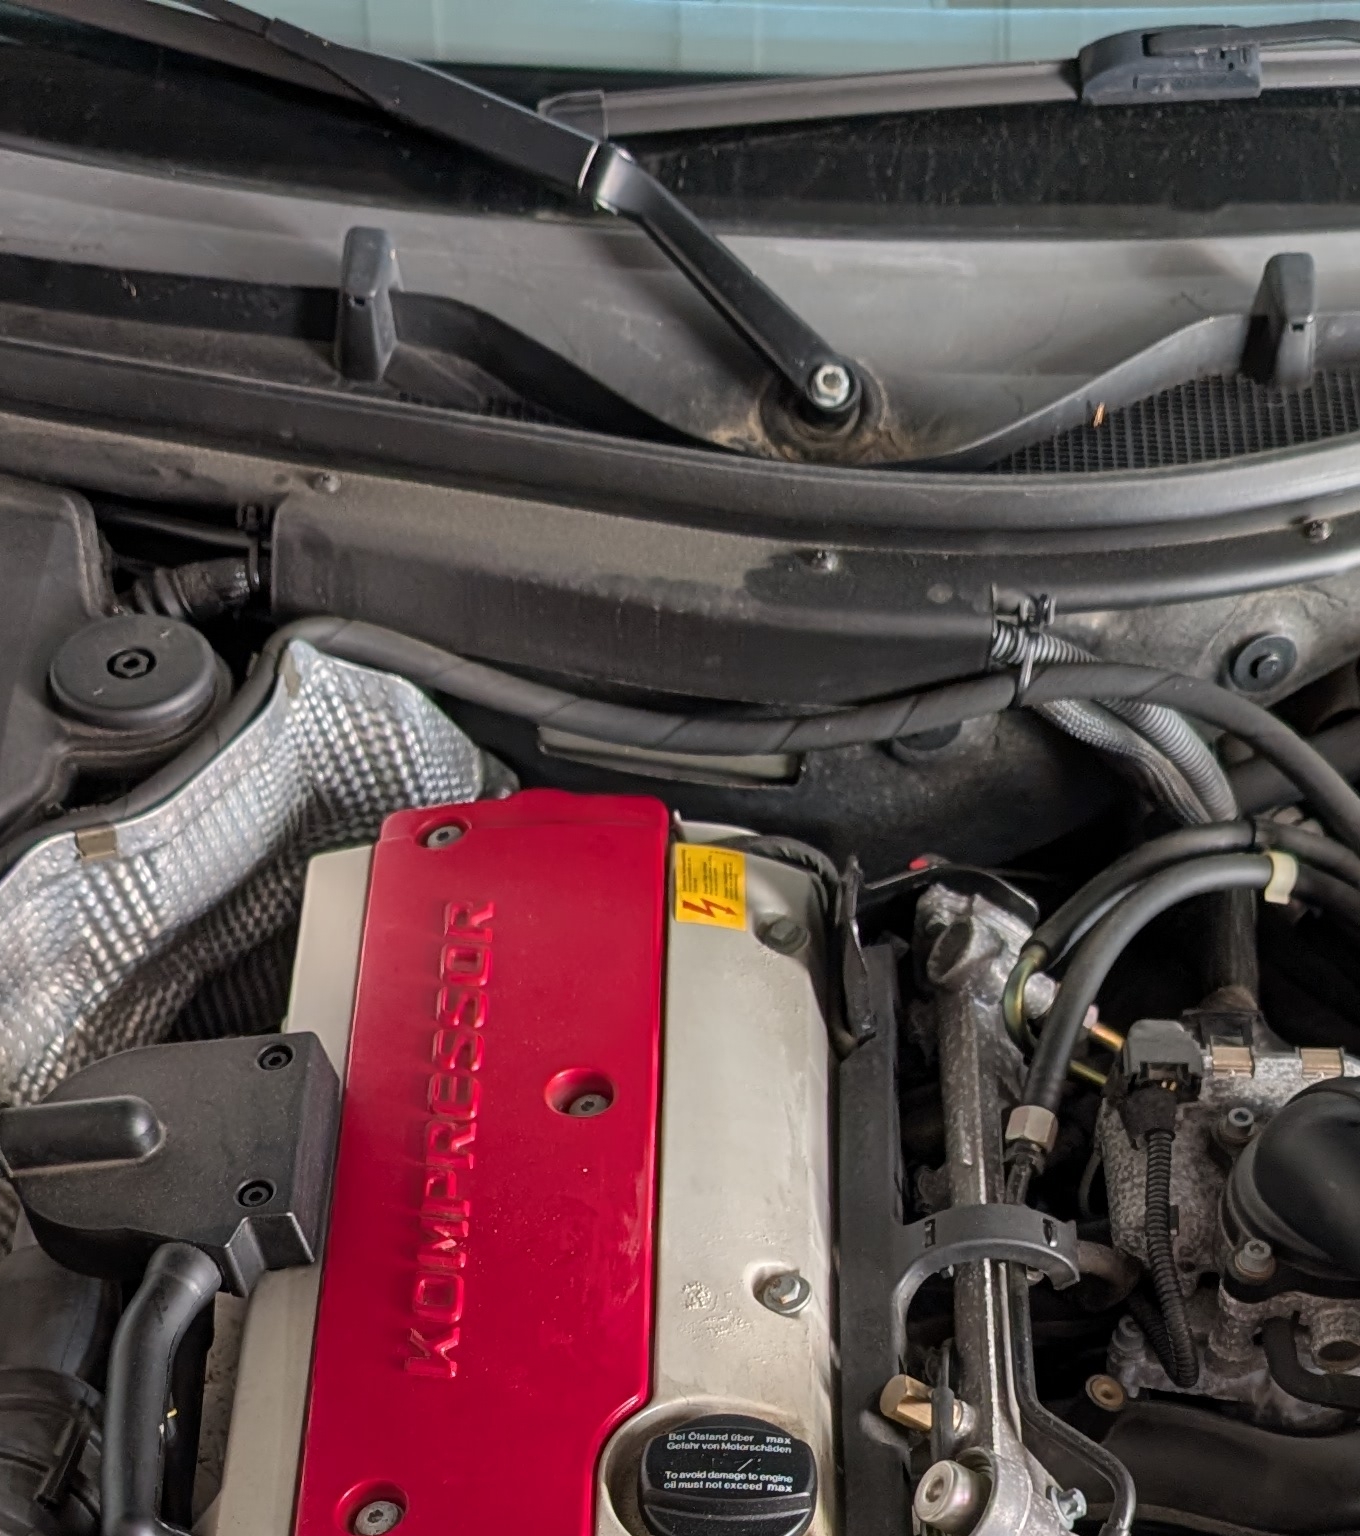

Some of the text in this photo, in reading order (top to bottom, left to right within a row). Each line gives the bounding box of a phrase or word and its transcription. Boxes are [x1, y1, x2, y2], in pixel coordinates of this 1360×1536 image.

[405, 901, 497, 1379] KOMPRESSOR
[666, 1442, 700, 1450] Gefahr
[766, 1435, 792, 1445] max
[664, 1470, 793, 1483] To avoid damage to engine
[664, 1480, 793, 1492] oil must not exceed max
